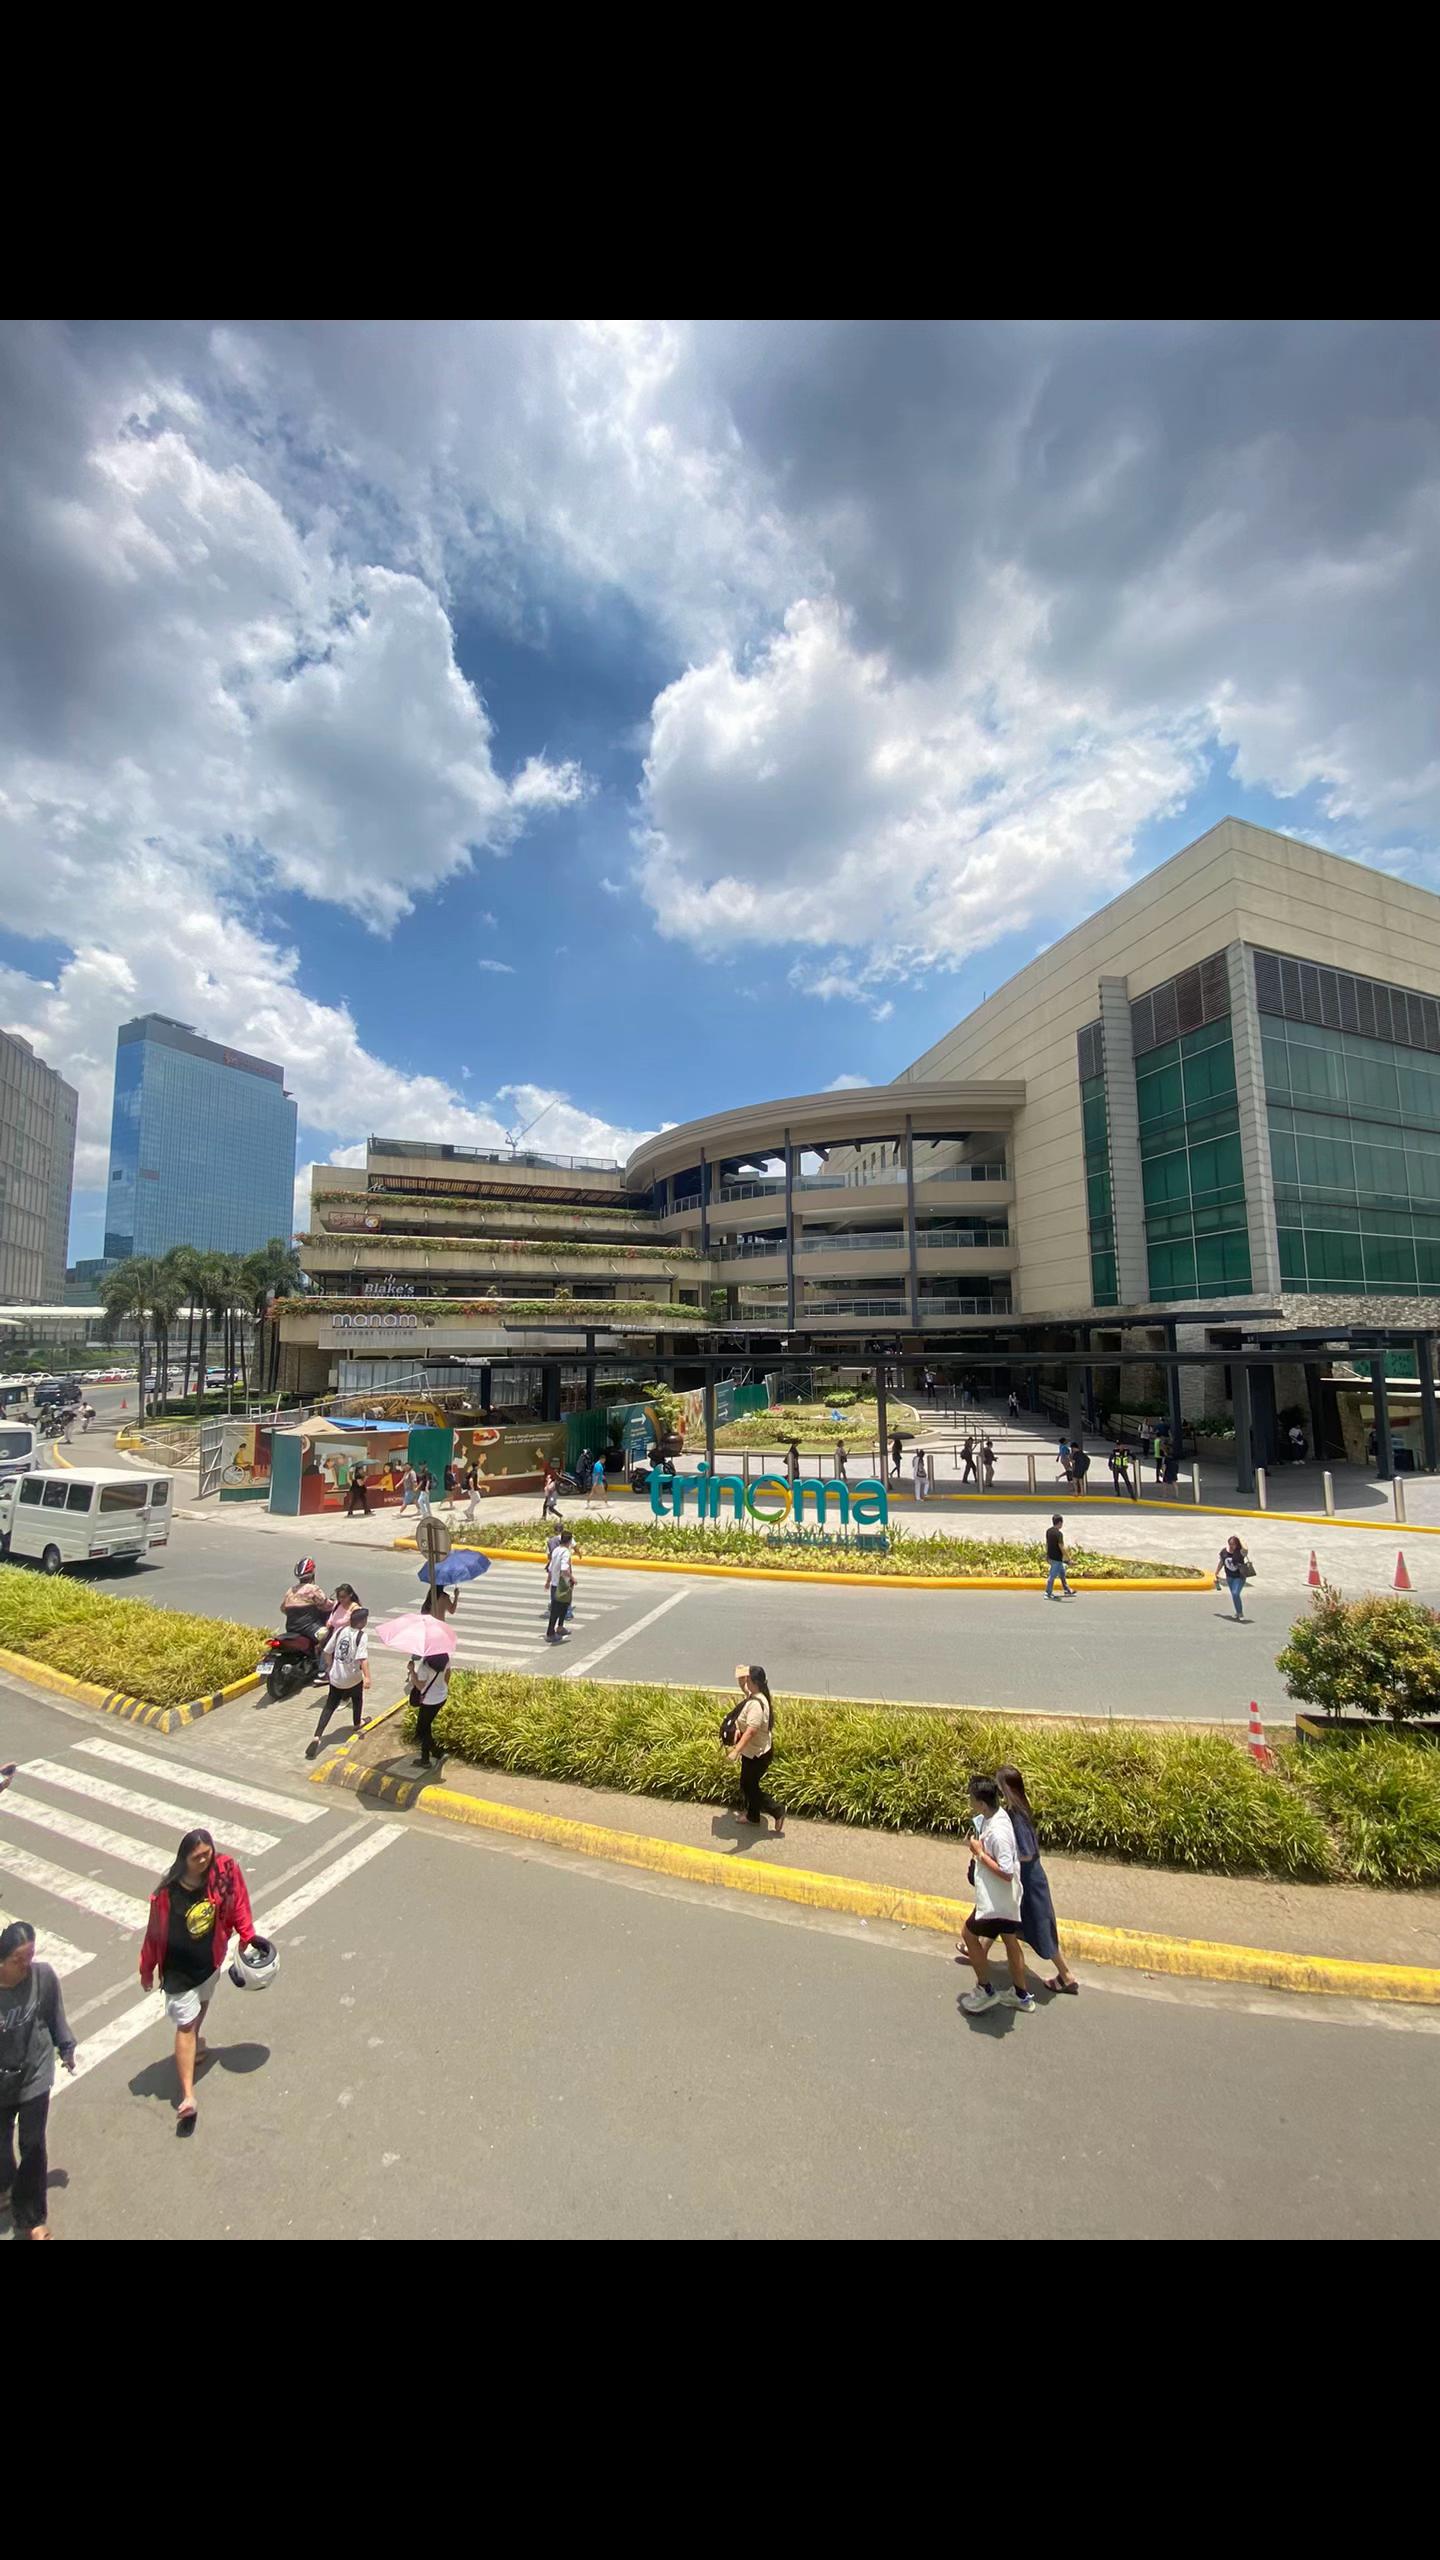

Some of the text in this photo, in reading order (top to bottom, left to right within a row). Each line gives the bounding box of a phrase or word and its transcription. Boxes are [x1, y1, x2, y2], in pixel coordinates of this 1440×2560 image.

[364, 1283, 415, 1294] Blake's
[332, 1313, 417, 1328] manam
[645, 1461, 889, 1525] trinoma
